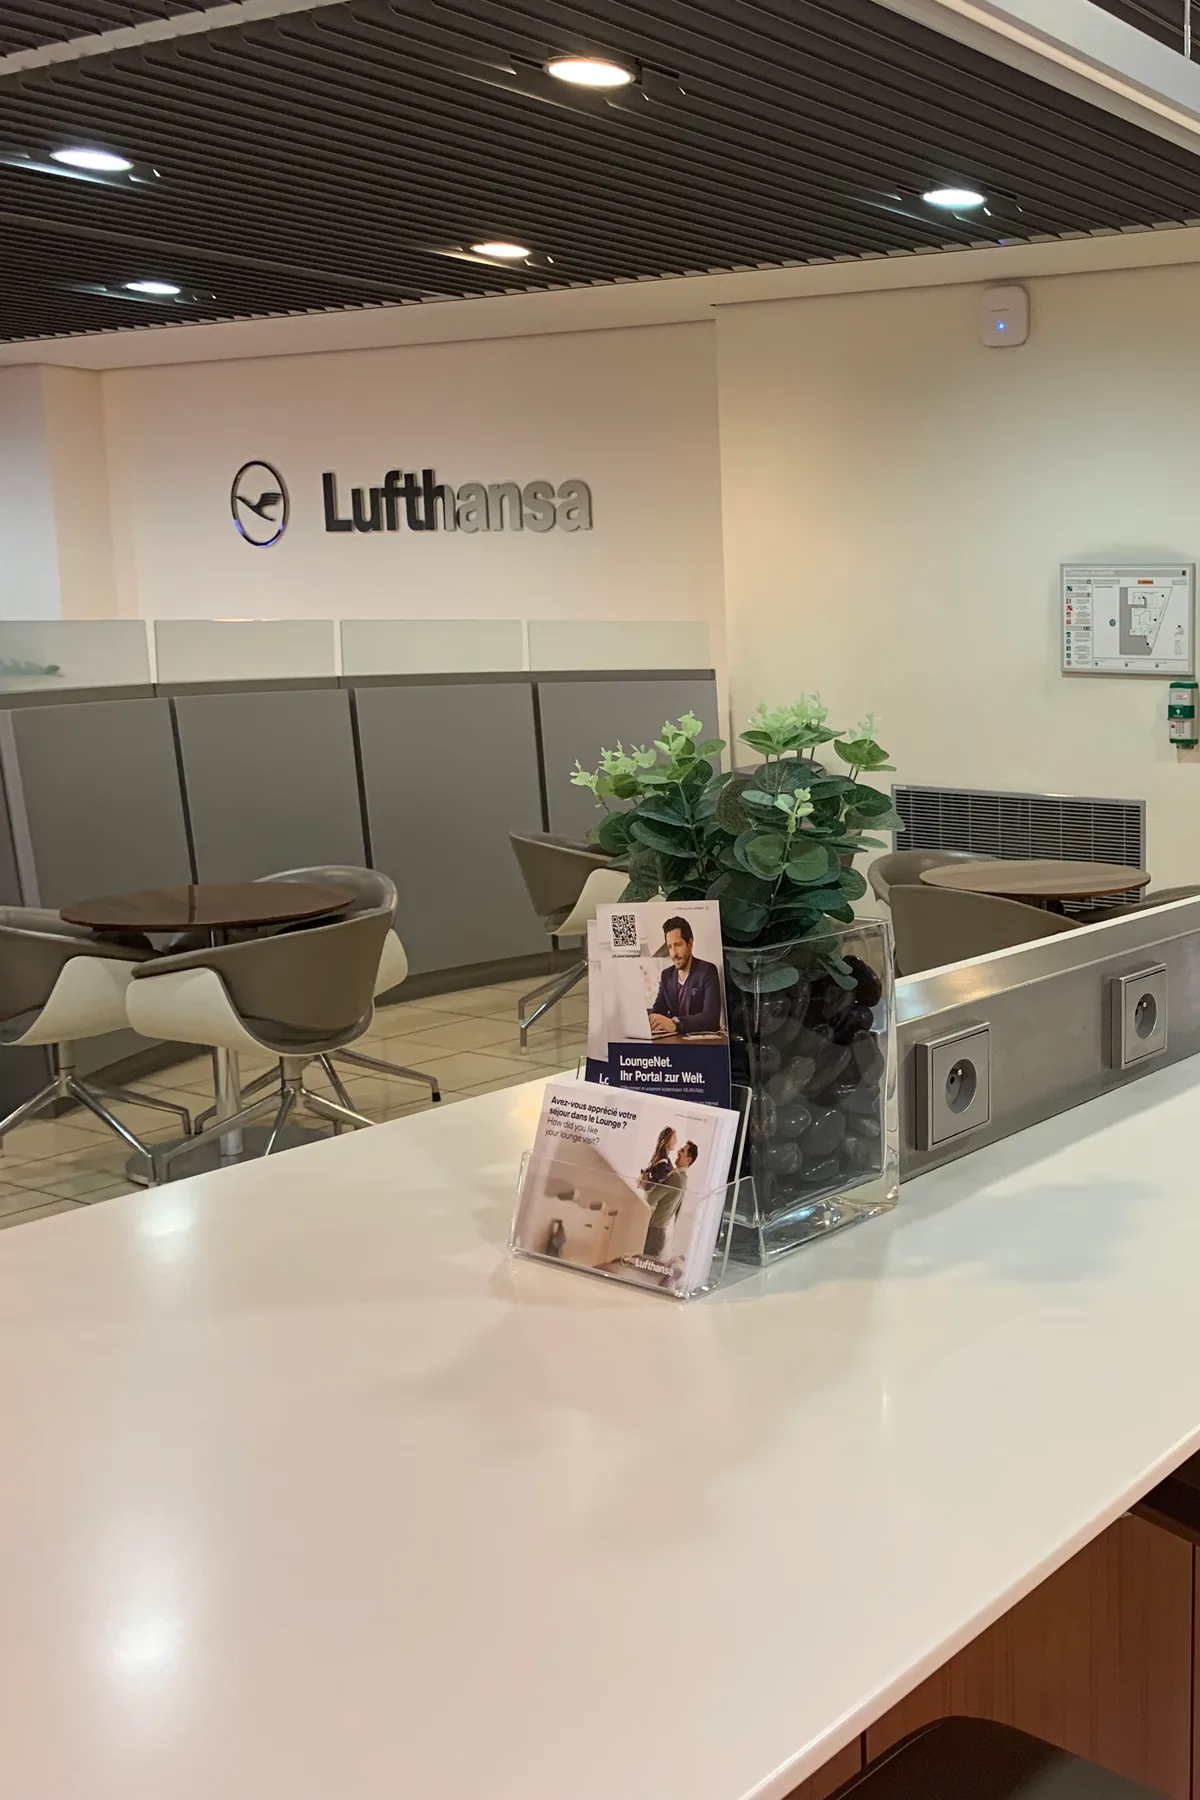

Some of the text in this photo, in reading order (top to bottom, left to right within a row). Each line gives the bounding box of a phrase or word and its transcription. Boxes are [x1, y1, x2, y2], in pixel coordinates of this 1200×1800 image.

[322, 468, 594, 533] Lufthansa
[620, 1055, 672, 1069] LoungeNet.
[620, 1070, 706, 1084] Ihr Portal zur Welt.
[551, 1096, 637, 1120] Avez-vous apprécié votre
[547, 1117, 598, 1134] How did you like
[549, 1107, 570, 1118] séjour
[571, 1111, 587, 1121] dans
[596, 1116, 622, 1129] Lounge
[623, 1121, 627, 1129] ?
[545, 1128, 600, 1145] your lounge visit?
[635, 1257, 673, 1276] Lufthansa
